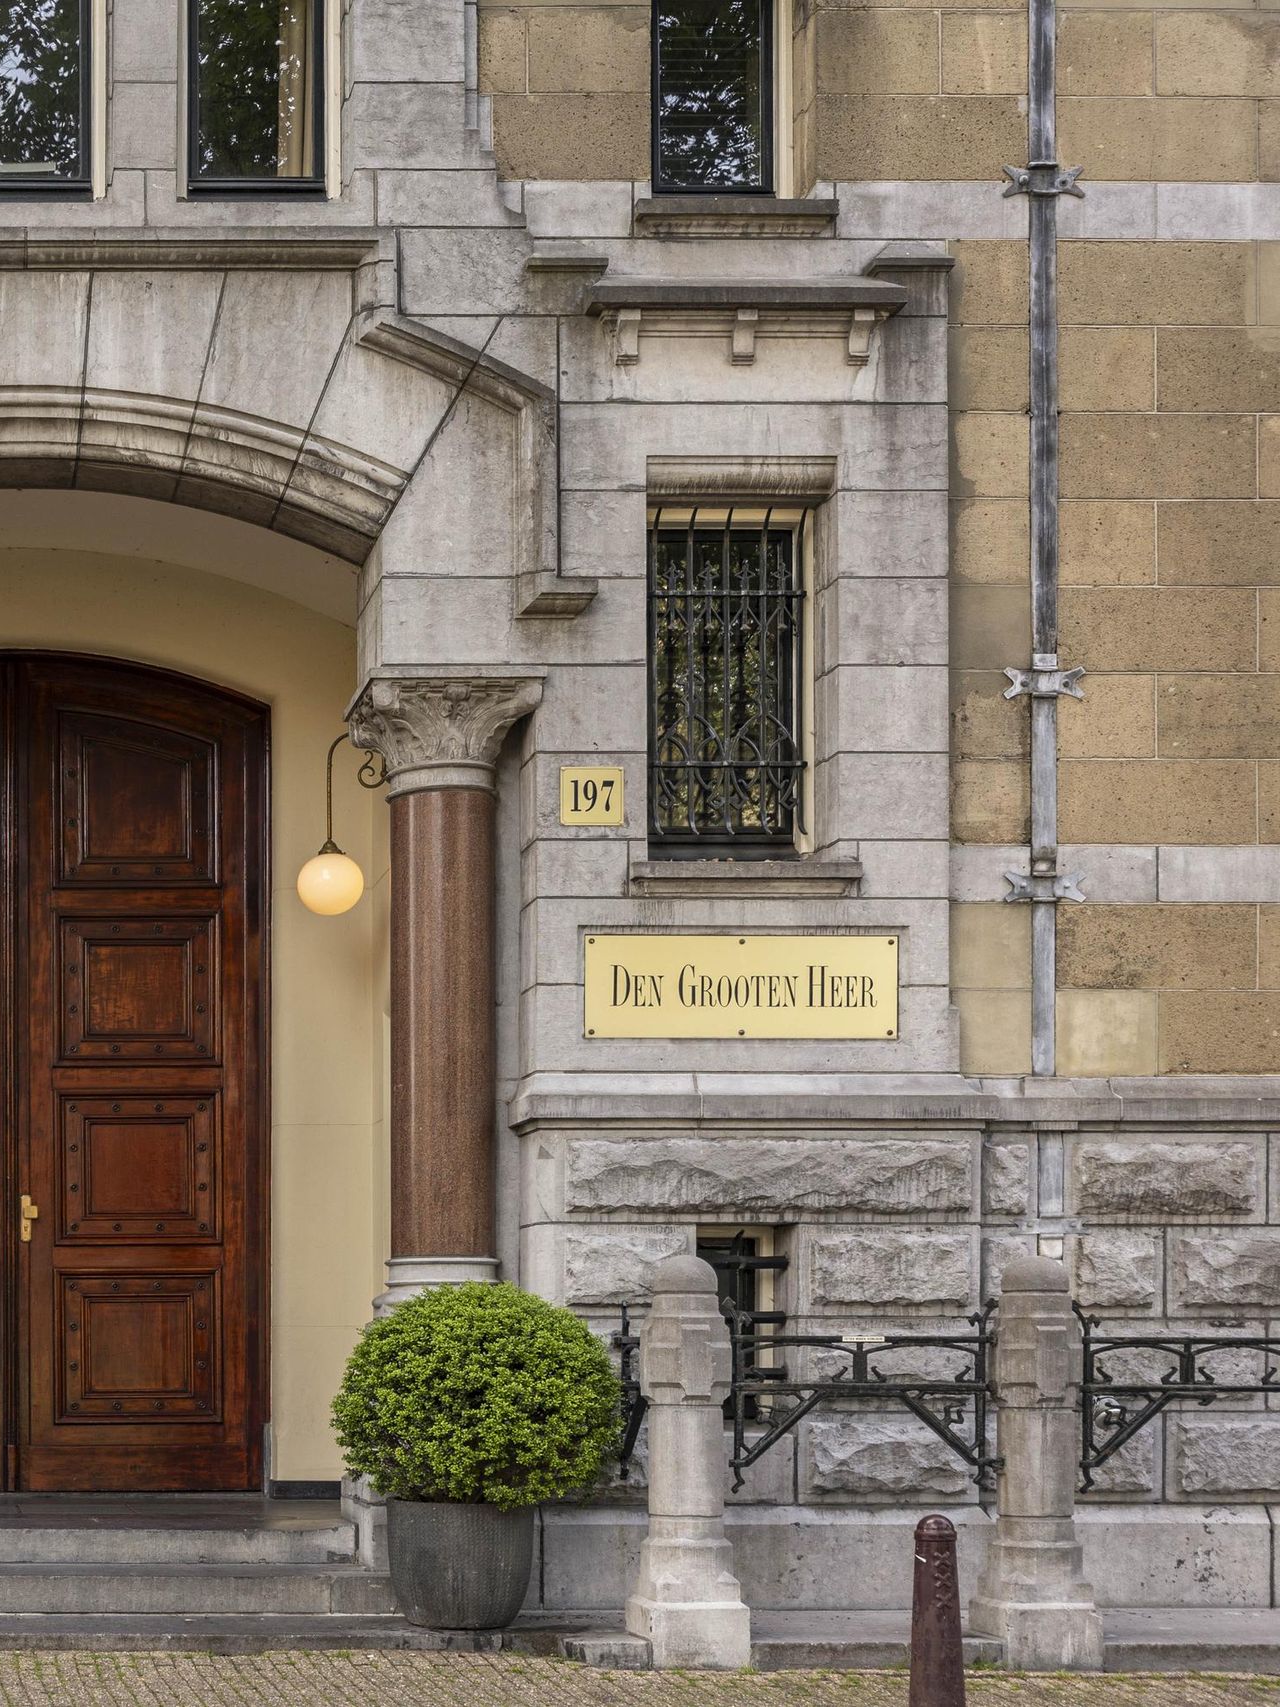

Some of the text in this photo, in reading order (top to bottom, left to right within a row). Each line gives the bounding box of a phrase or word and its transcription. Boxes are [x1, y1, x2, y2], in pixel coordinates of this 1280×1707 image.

[569, 779, 615, 813] 197
[611, 964, 878, 1008] DEN GROOTEN HEER
